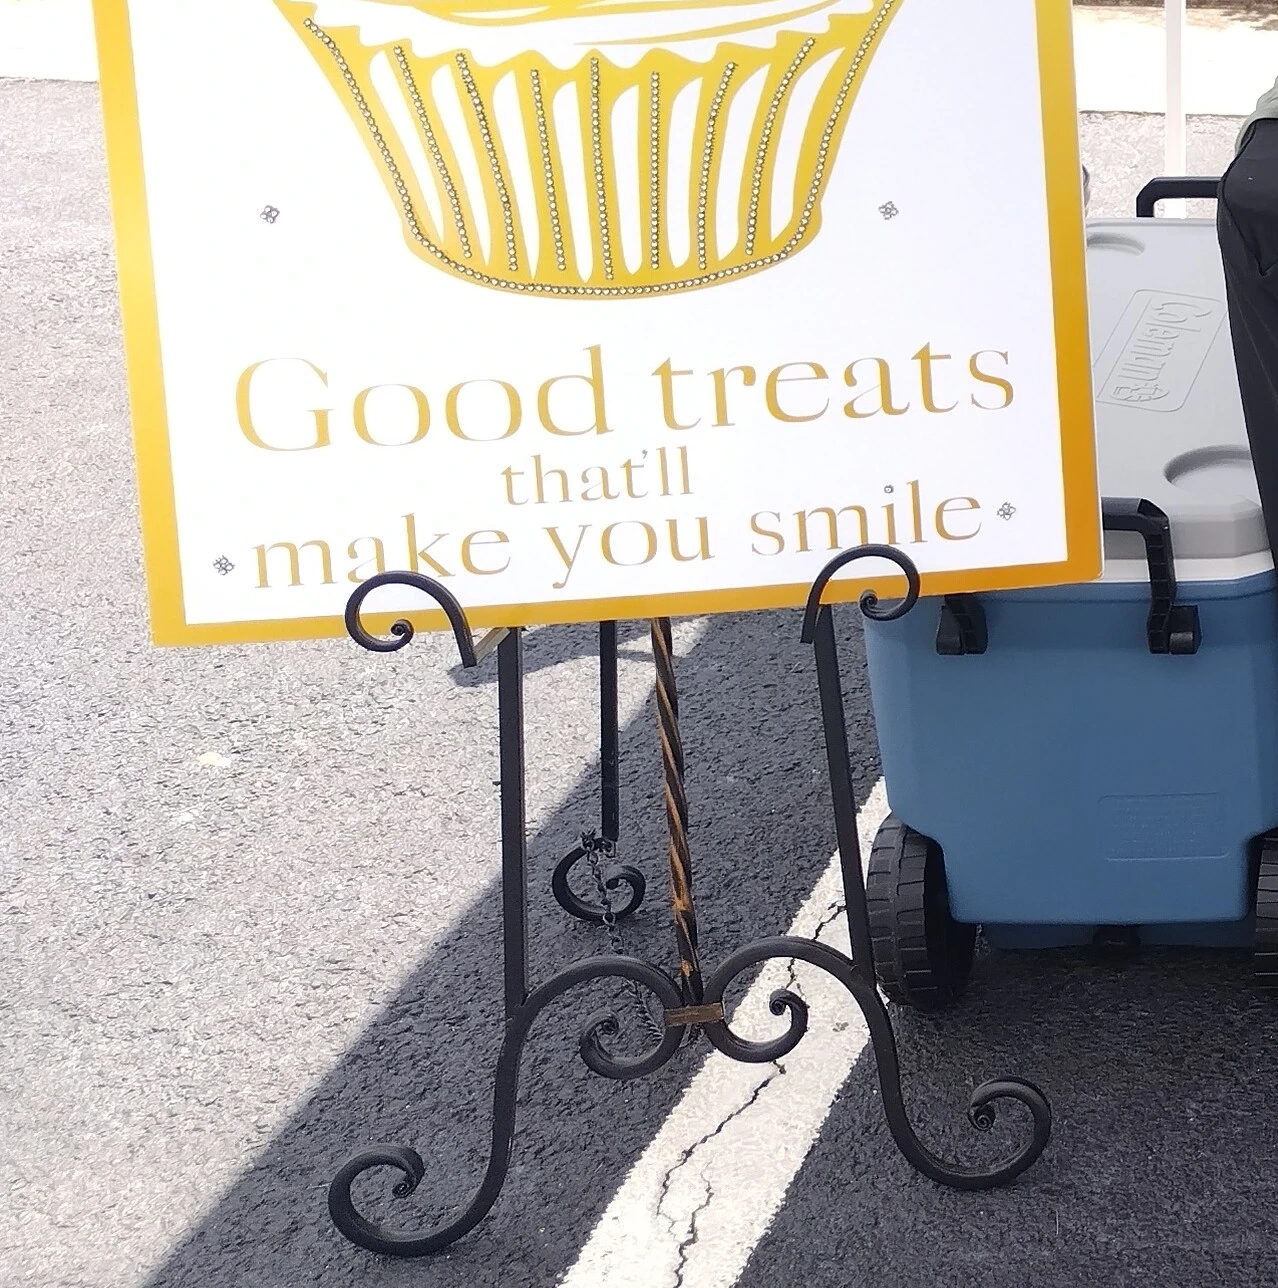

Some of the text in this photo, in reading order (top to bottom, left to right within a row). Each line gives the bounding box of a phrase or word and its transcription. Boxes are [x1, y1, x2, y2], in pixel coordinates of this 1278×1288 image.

[1118, 302, 1213, 382] Coleman
[235, 341, 1015, 452] Good treats
[501, 446, 694, 506] that'll
[253, 480, 983, 589] make you smile
